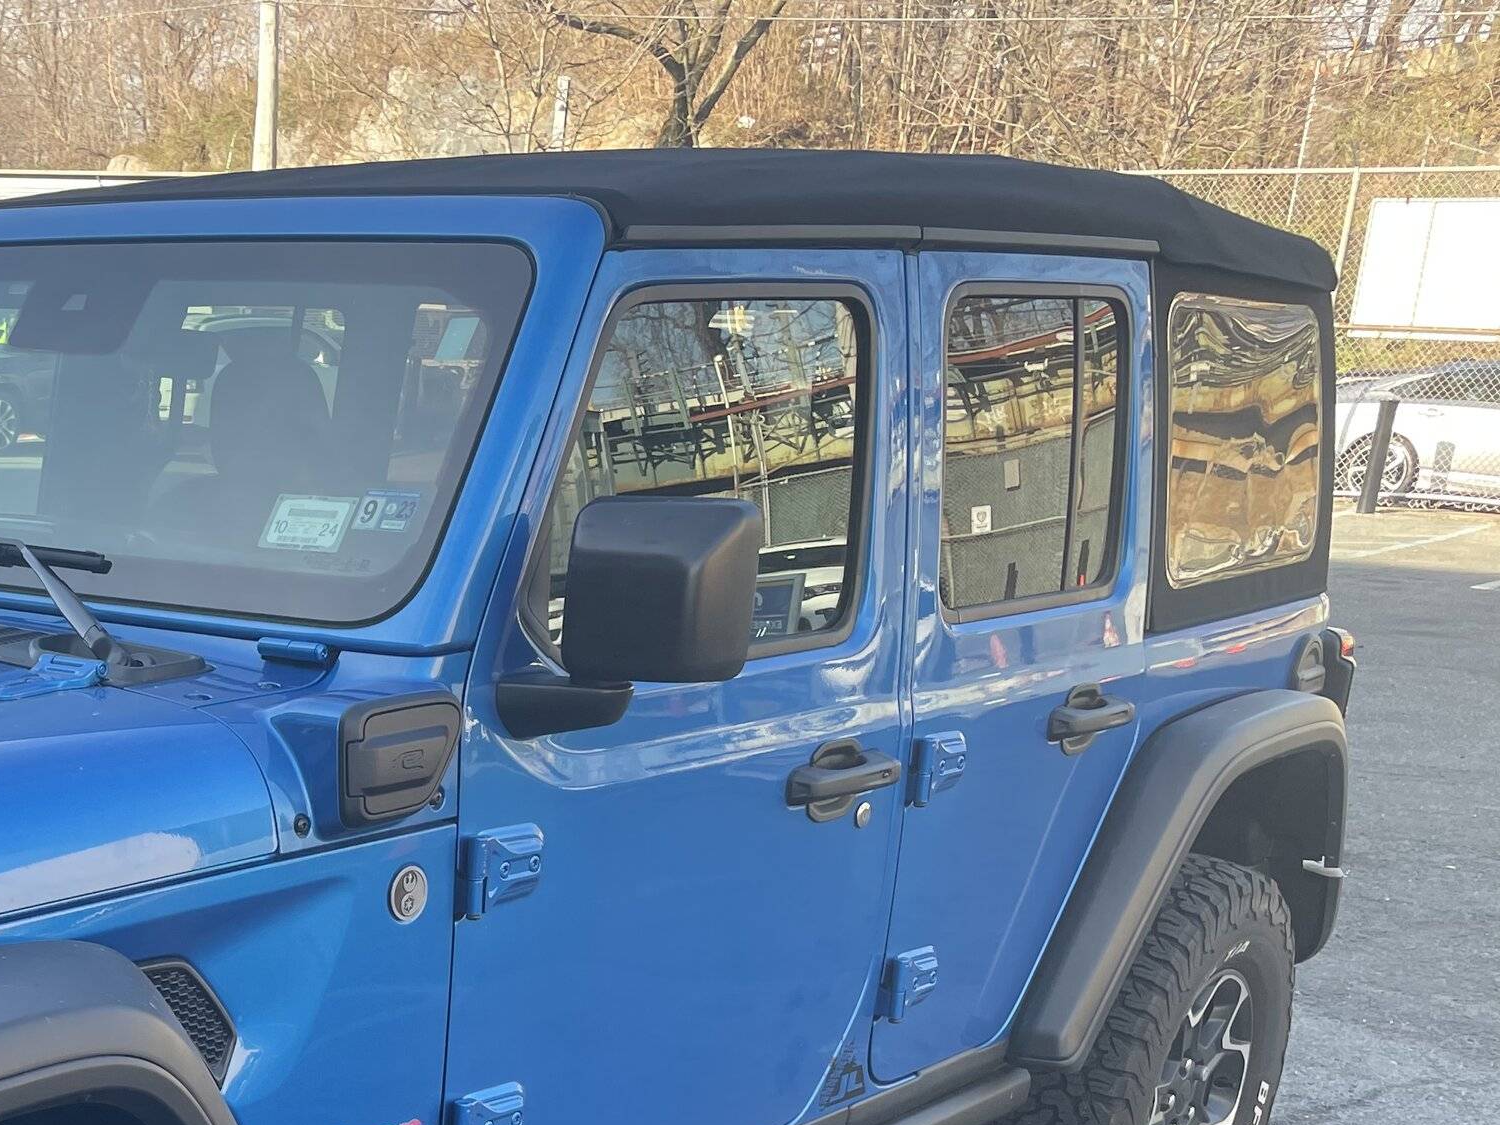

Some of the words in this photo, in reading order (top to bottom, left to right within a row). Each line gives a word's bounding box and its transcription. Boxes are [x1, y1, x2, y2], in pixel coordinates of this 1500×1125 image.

[360, 500, 378, 523] 9
[274, 520, 288, 534] 10
[318, 522, 338, 537] 24
